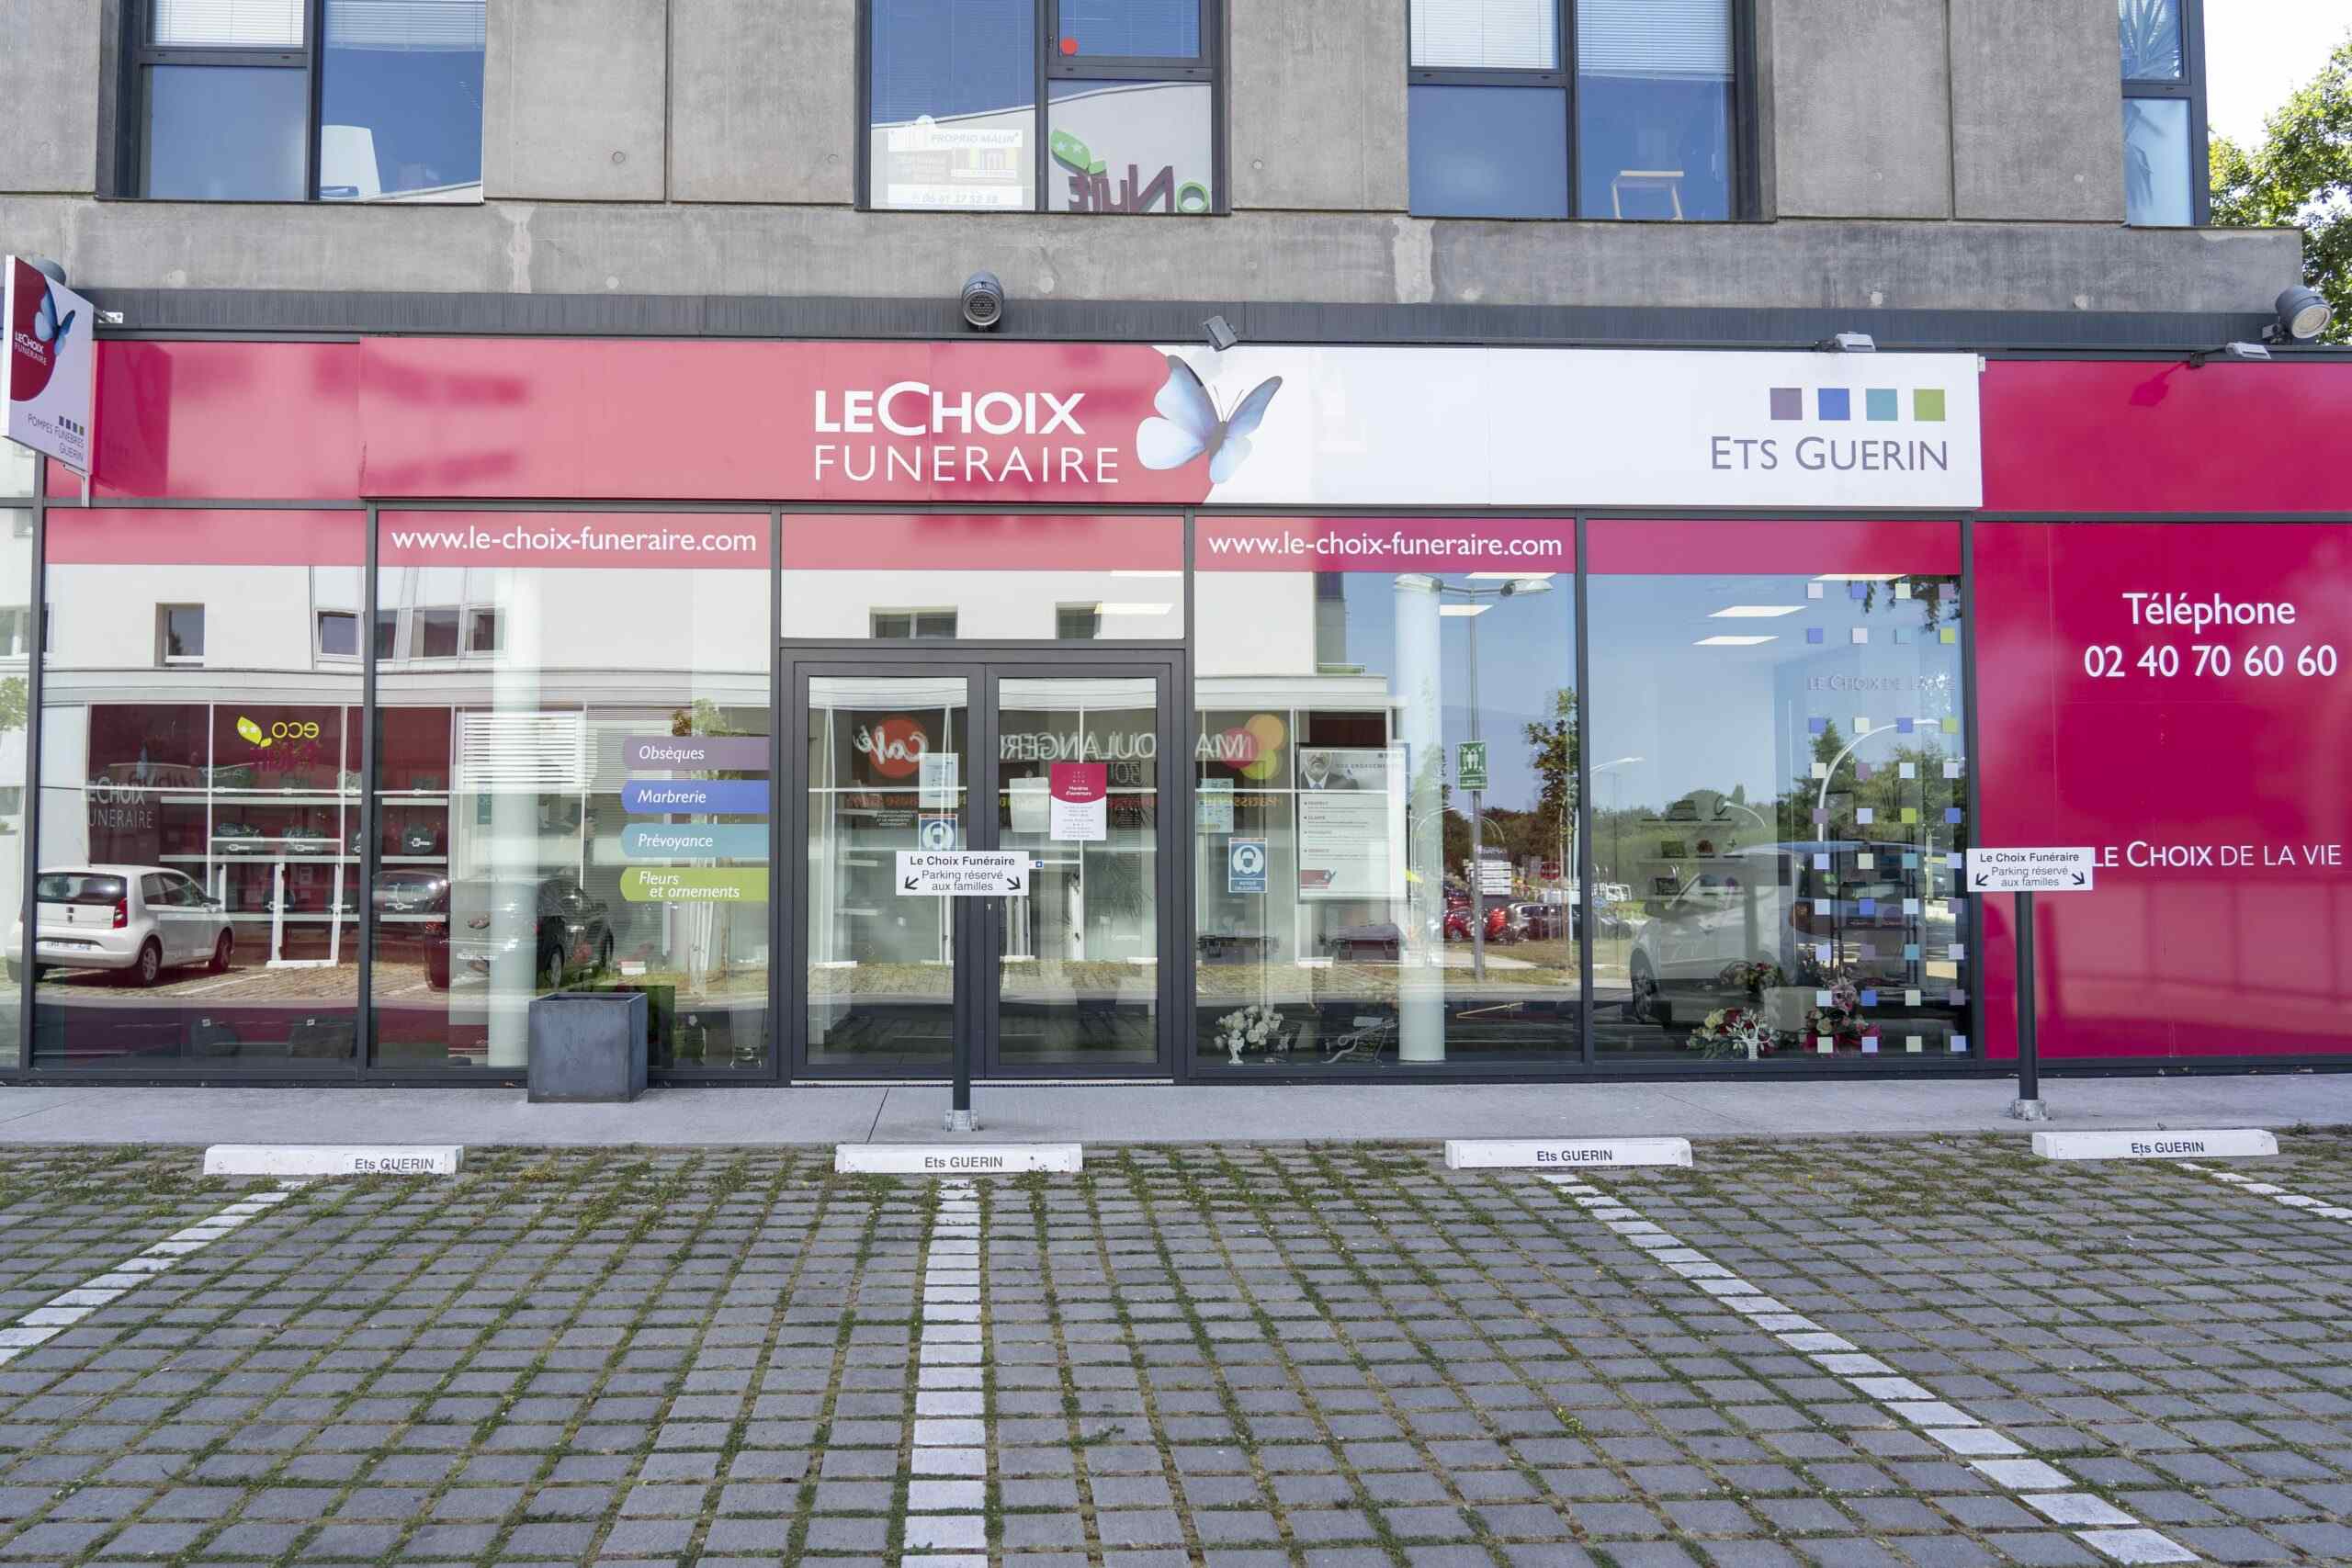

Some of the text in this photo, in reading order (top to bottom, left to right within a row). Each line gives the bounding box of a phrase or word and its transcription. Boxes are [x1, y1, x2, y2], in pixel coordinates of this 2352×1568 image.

[28, 413, 53, 435] POMPES
[1712, 435, 1948, 470] ETS GUERIN
[815, 445, 1119, 483] FUNERAIRE
[391, 525, 756, 551] www.le-choix-funeraire.com
[1208, 531, 1563, 556] www.le-choix-funeraire.com
[2122, 592, 2296, 634] Téléphone
[2084, 645, 2338, 677] 02 40 70 60 60
[639, 745, 705, 763] Obsèques
[638, 790, 707, 804] Marbrerie
[87, 808, 154, 829] UNERAIRE
[639, 833, 714, 852] Prévoyance
[1980, 852, 2079, 863] Le Choix Funéraire
[2126, 840, 2213, 867] CHOIX
[2221, 846, 2254, 866] DE
[2264, 845, 2296, 866] LA
[2302, 844, 2342, 865] VIE
[910, 856, 1015, 866] Le Choix Funéraire
[639, 871, 680, 885] Fleurs
[922, 870, 1003, 882] Parking réservé
[1992, 866, 2068, 878] Parking réservé
[932, 881, 993, 891] aux familles
[2022, 877, 2059, 886] familles
[650, 886, 741, 897] et ornements
[2132, 1142, 2205, 1153] Ets GUERIN
[924, 1156, 1003, 1168] Ets GUERIN
[1537, 1150, 1612, 1161] Ets GUERIN
[355, 1157, 435, 1169] Ets GUERIN
